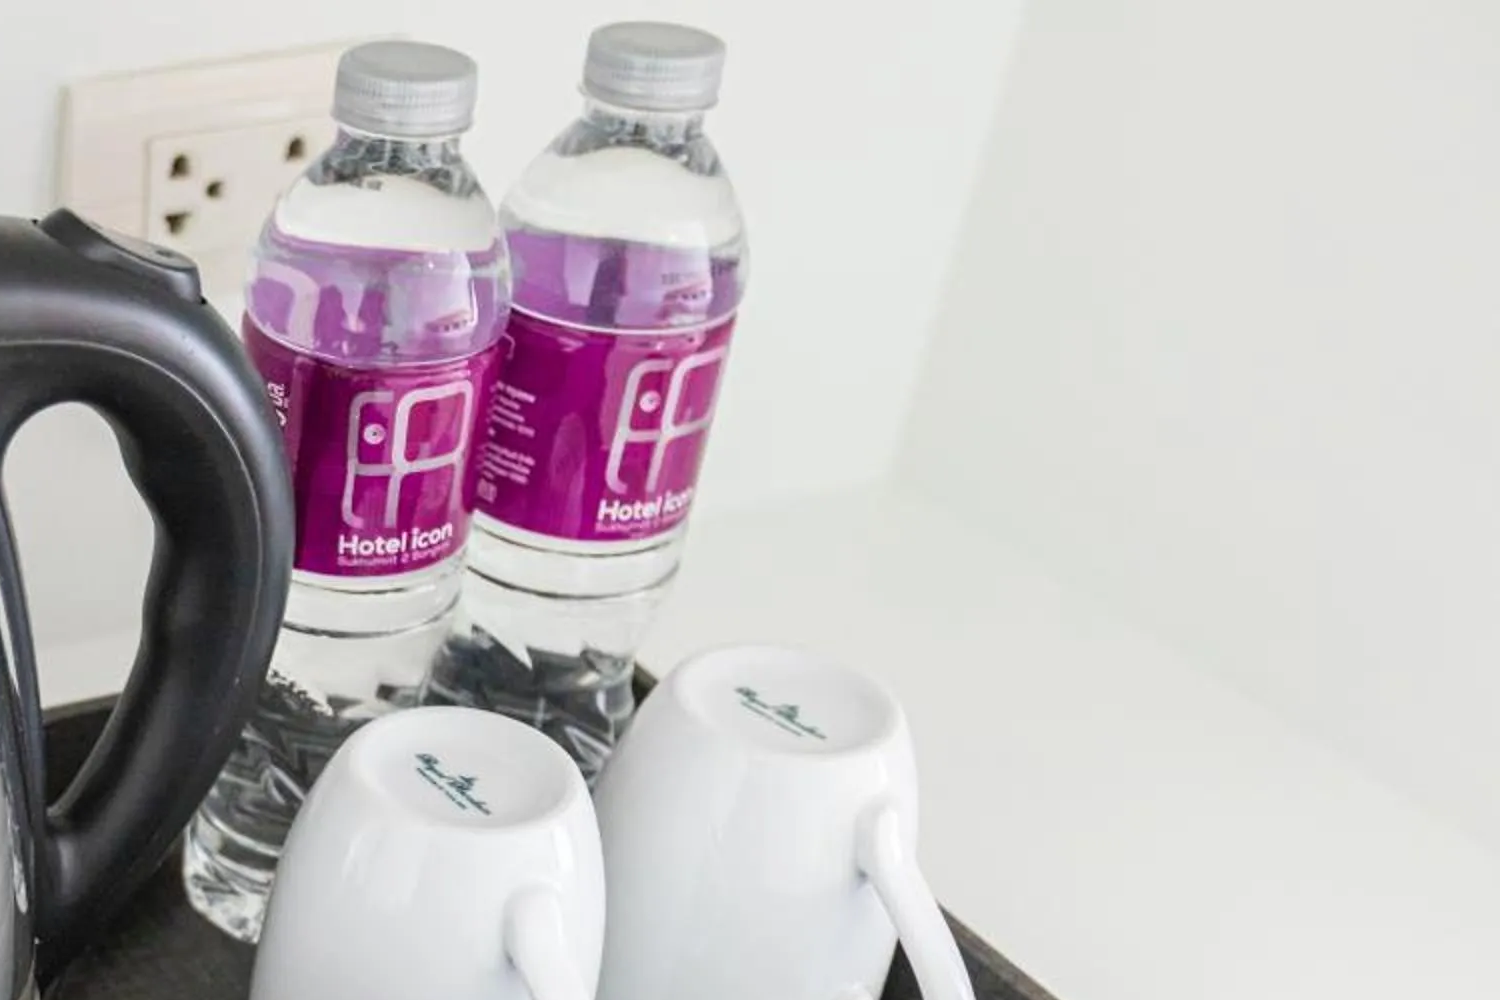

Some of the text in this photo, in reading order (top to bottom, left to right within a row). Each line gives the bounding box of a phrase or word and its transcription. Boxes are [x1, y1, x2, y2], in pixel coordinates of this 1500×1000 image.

[597, 495, 662, 522] Hotel
[338, 531, 408, 556] Hotel
[410, 521, 453, 550] icon
